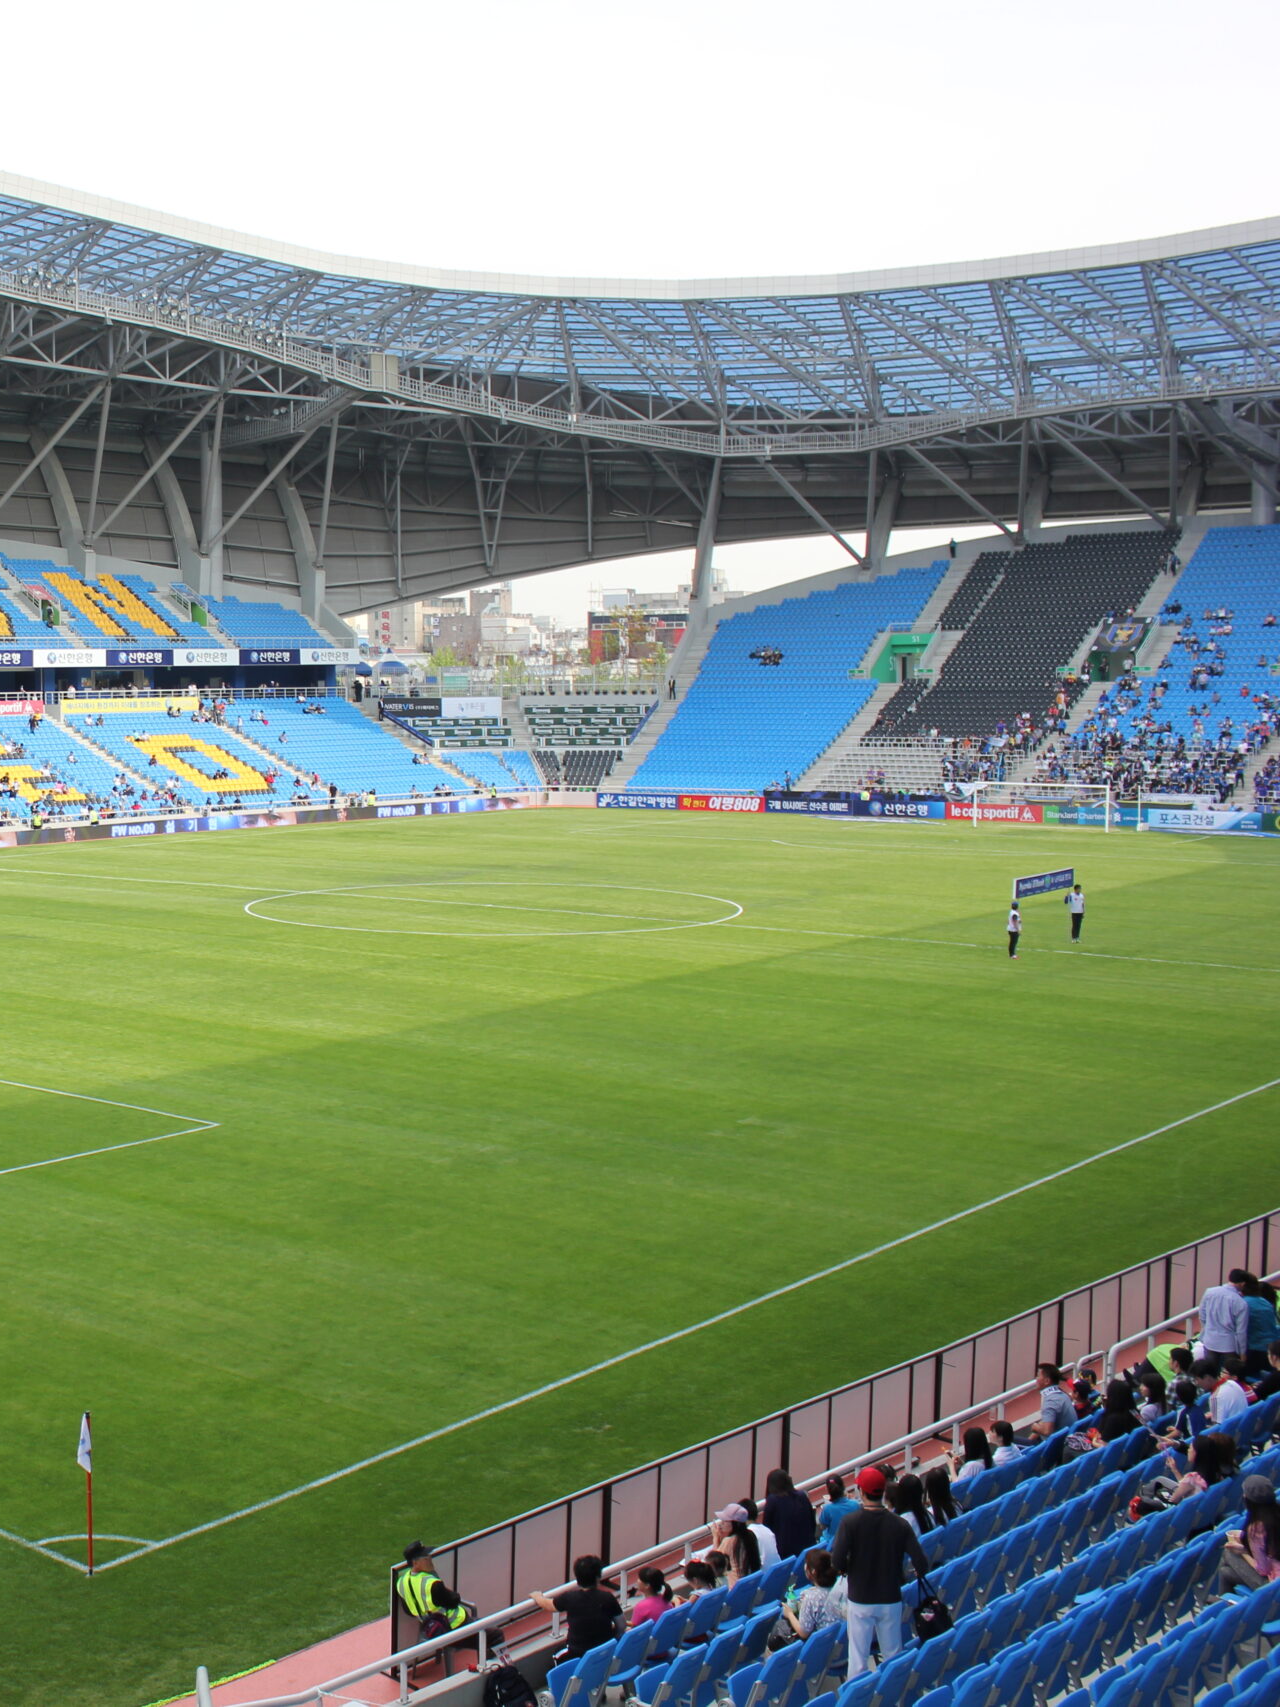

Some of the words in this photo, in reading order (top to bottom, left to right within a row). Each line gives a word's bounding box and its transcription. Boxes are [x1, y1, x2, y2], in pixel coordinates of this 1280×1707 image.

[58, 652, 93, 663] 신한은행
[128, 652, 163, 663] 신한은행
[195, 651, 228, 663] 신한은행
[259, 651, 291, 662] 신한은행
[321, 651, 350, 662] 신한은행
[617, 796, 676, 808] 한길안과병원
[709, 796, 760, 811] 여명808
[782, 802, 808, 811] 아시아드
[809, 802, 828, 812] 선수촌
[829, 802, 848, 812] 아파트
[884, 803, 928, 816] 신한은행
[951, 805, 961, 817] le
[962, 808, 982, 820] coq
[984, 806, 1020, 820] sportif
[1159, 813, 1214, 826] 포스코건설
[111, 825, 127, 837] FW
